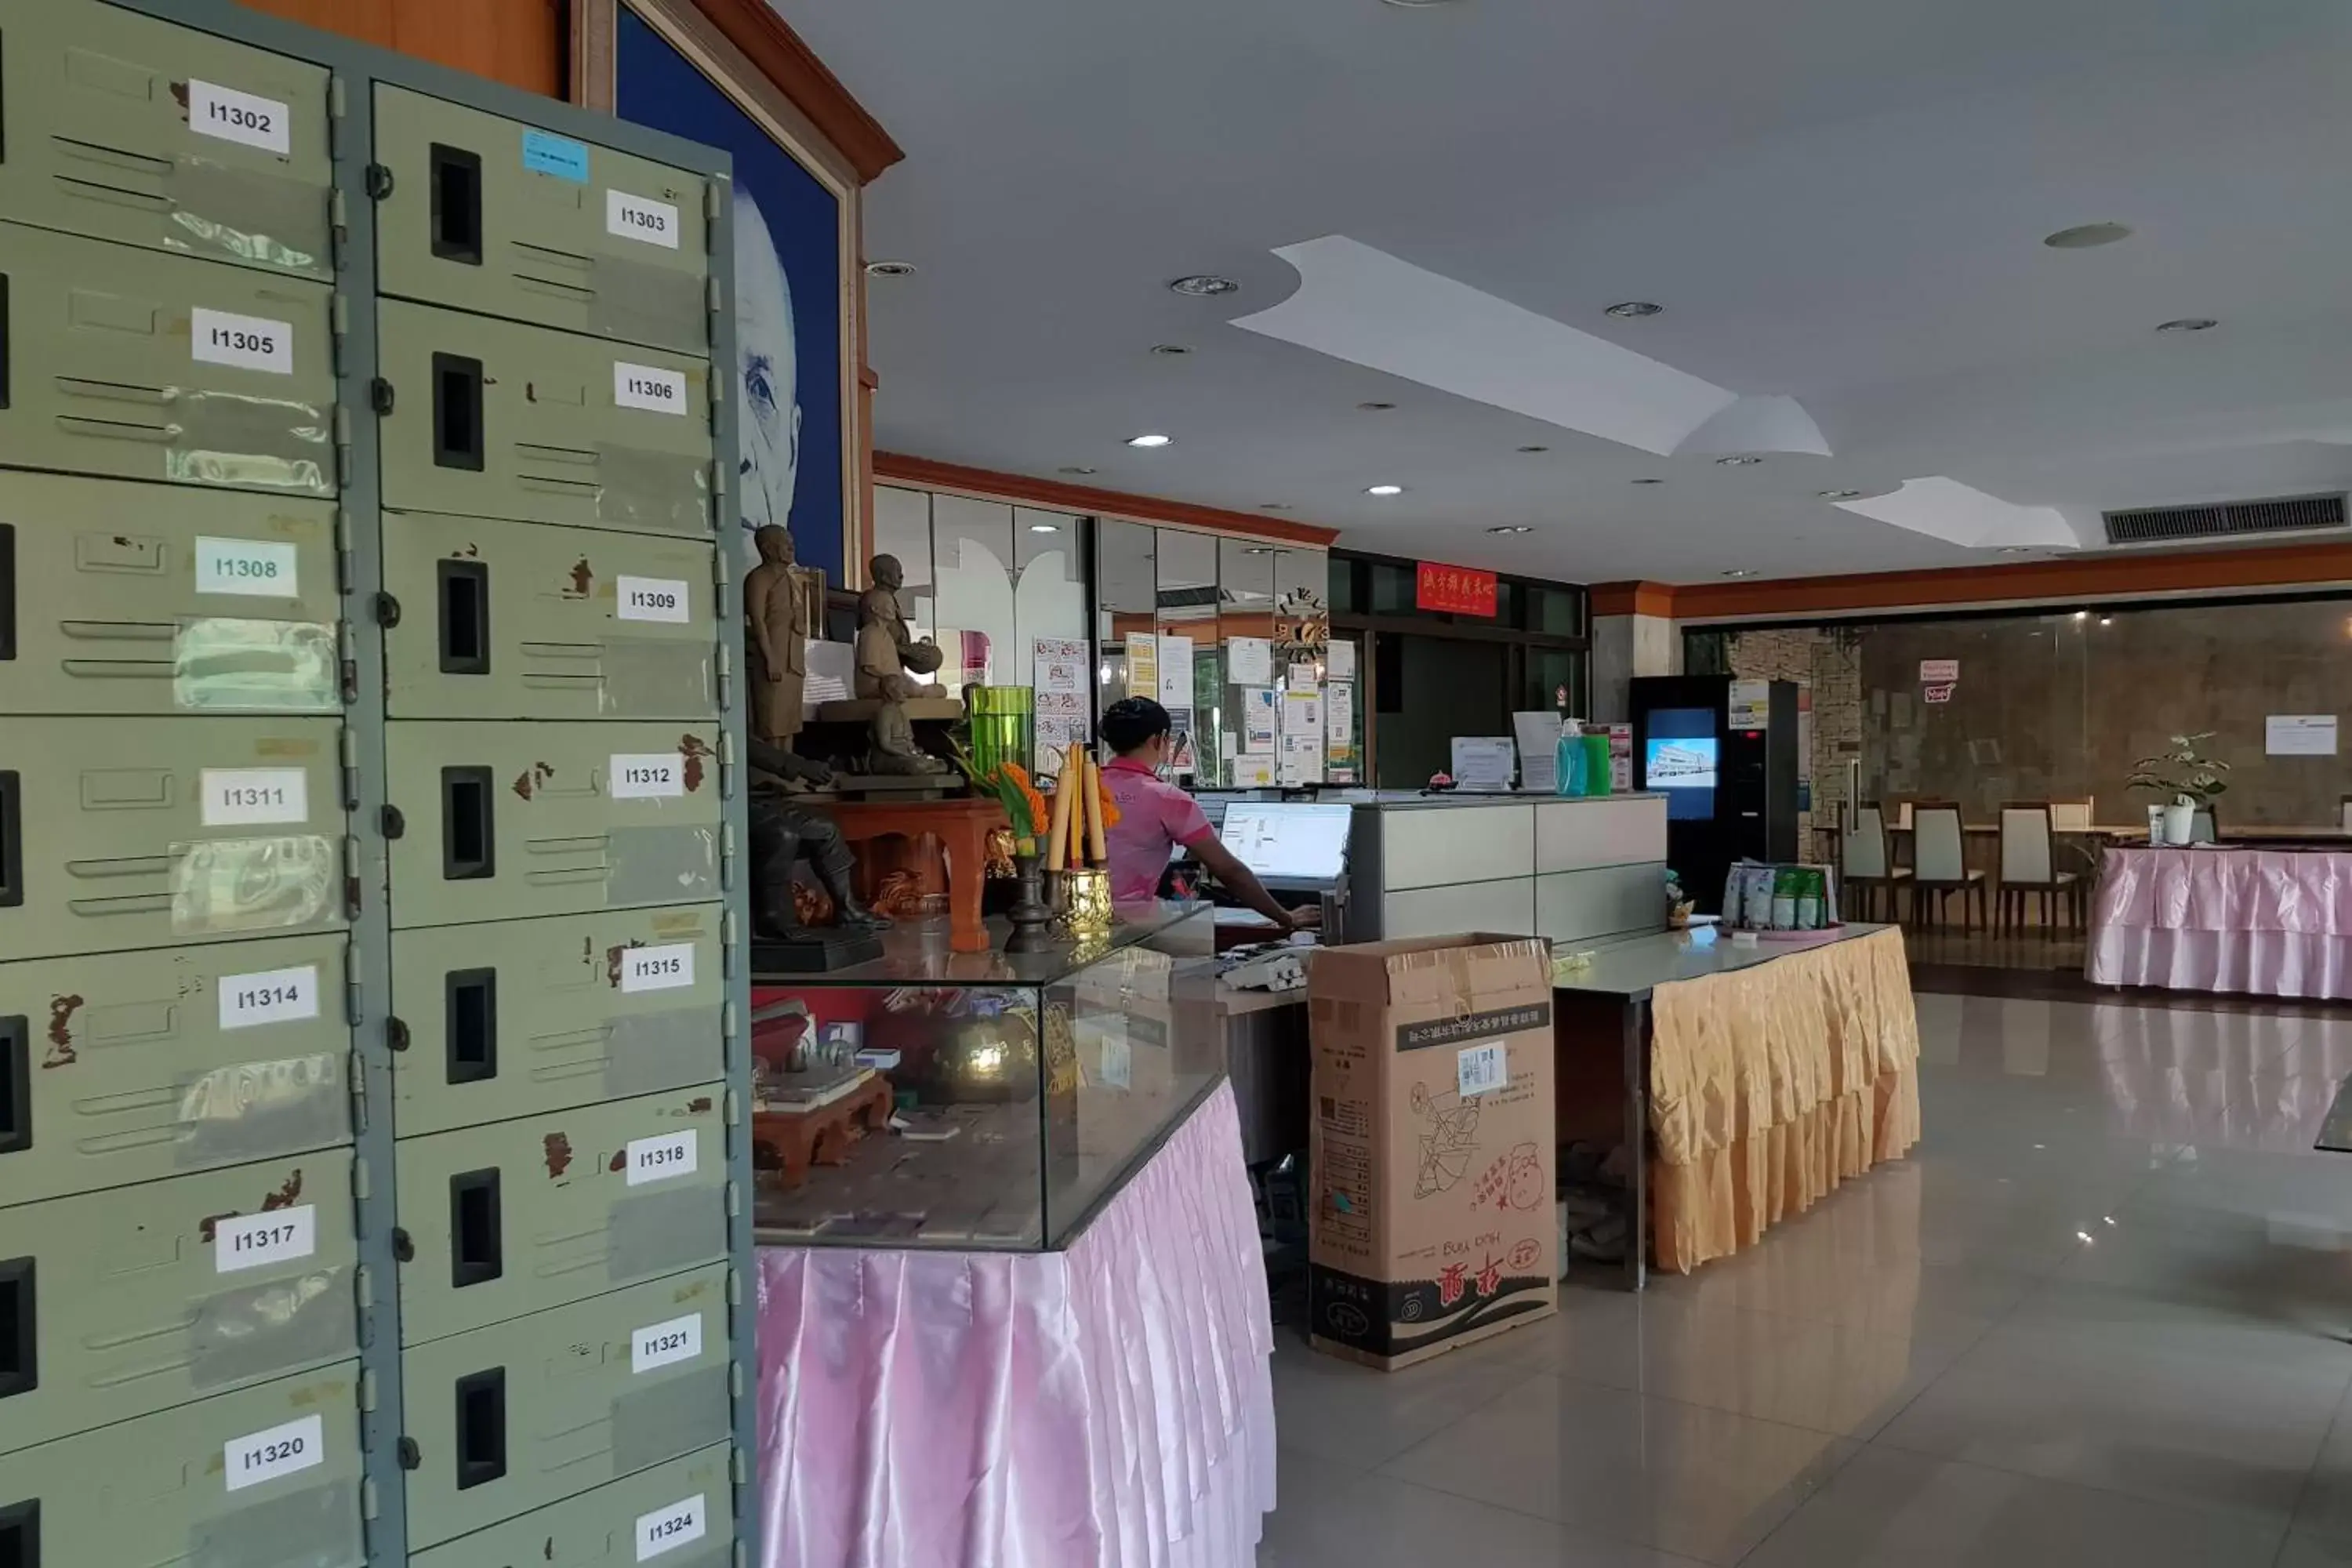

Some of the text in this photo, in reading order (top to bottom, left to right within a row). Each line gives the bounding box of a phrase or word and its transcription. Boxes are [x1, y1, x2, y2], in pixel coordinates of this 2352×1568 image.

[209, 100, 272, 133] I1302
[621, 206, 666, 234] I1303
[213, 328, 274, 354] I1305
[629, 379, 673, 399] I1306
[216, 558, 277, 578] I1308
[632, 592, 675, 608] I1309
[626, 768, 670, 783] I1312
[224, 788, 283, 807] I1311
[636, 958, 680, 976] I1315
[238, 985, 299, 1009] I1314
[641, 1145, 684, 1167] I1318
[235, 1225, 295, 1252] I1317
[1443, 1240, 1471, 1256] Ying
[645, 1331, 689, 1356] I1321
[244, 1438, 305, 1471] I1320
[649, 1513, 694, 1541] I1324
